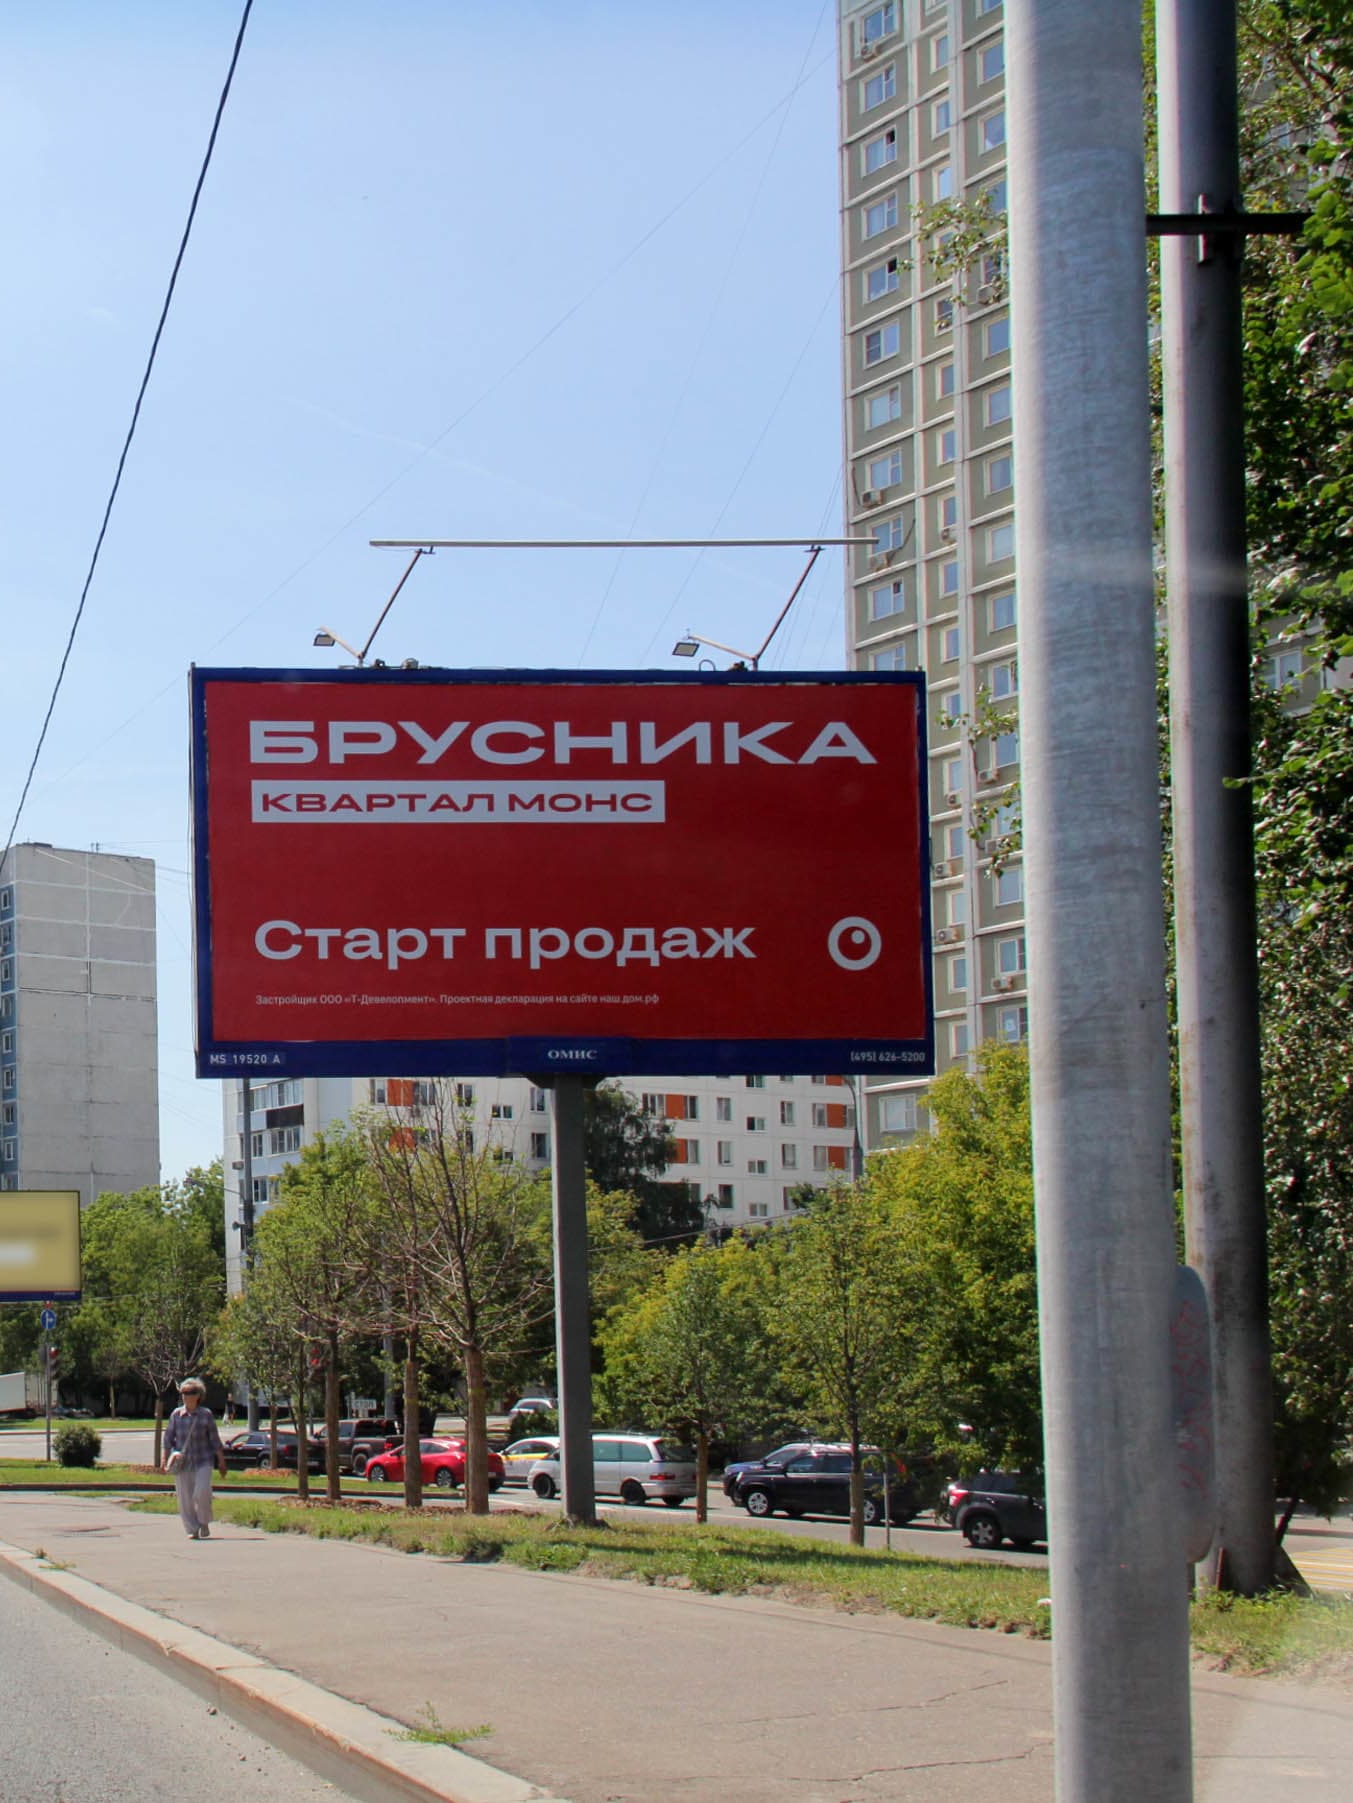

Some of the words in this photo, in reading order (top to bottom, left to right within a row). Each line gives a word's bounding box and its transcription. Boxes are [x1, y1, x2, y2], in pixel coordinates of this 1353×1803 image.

[249, 720, 877, 765] БРУСНИКА
[262, 792, 496, 813] КВАРТАЛ
[508, 792, 654, 813] МОНС
[254, 919, 467, 970] Старт
[485, 927, 757, 970] продаж
[255, 993, 318, 1006] Застройщик
[319, 994, 342, 1005] ООО
[439, 994, 494, 1006] Проектная
[494, 995, 554, 1006] декларация
[555, 995, 568, 1004] на
[569, 993, 598, 1004] сайте
[209, 1053, 227, 1065] MS
[232, 1053, 268, 1065] 19520
[271, 1053, 281, 1065] A
[547, 1049, 598, 1060] ОМИС
